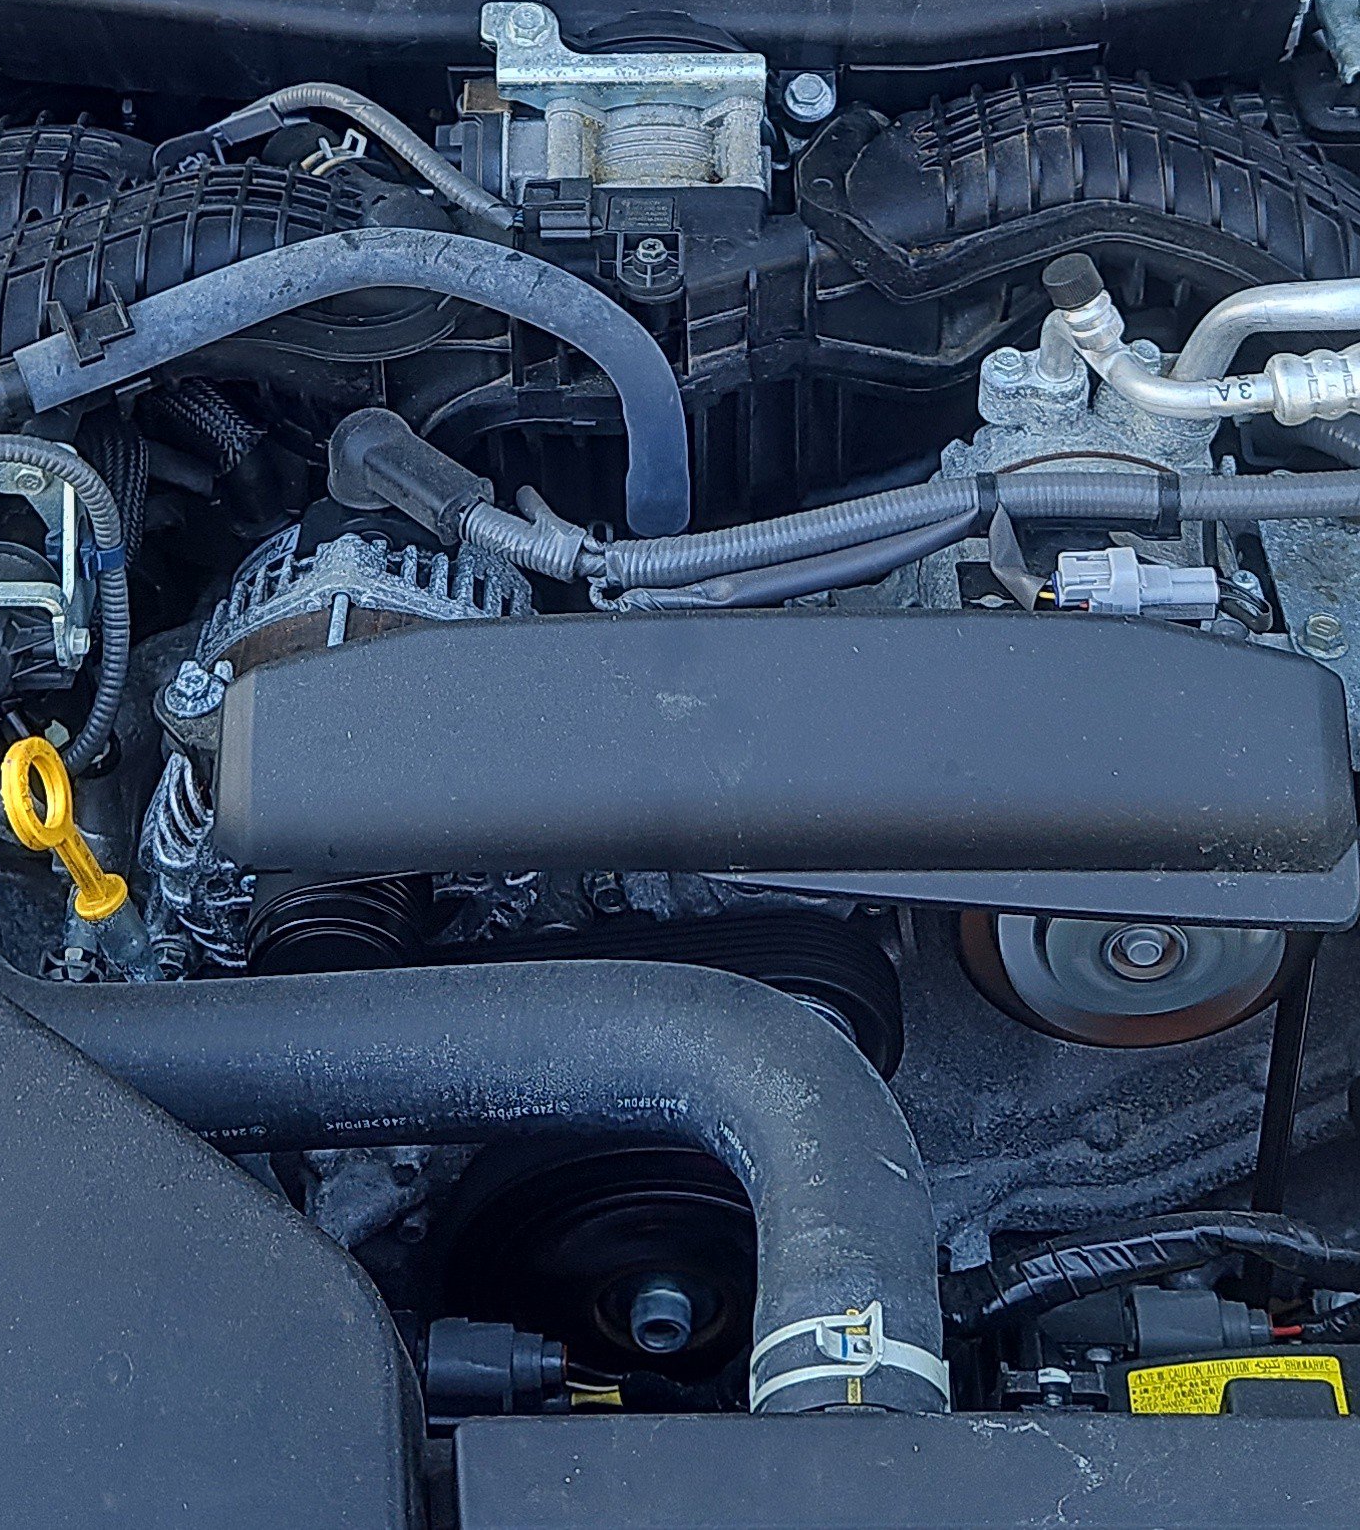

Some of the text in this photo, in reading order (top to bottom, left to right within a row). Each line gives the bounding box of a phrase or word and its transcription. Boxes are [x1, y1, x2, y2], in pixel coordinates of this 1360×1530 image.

[1169, 1362, 1250, 1381] CAUTION ATTENTION
[1284, 1359, 1330, 1371] ВНИМАНИЕ
